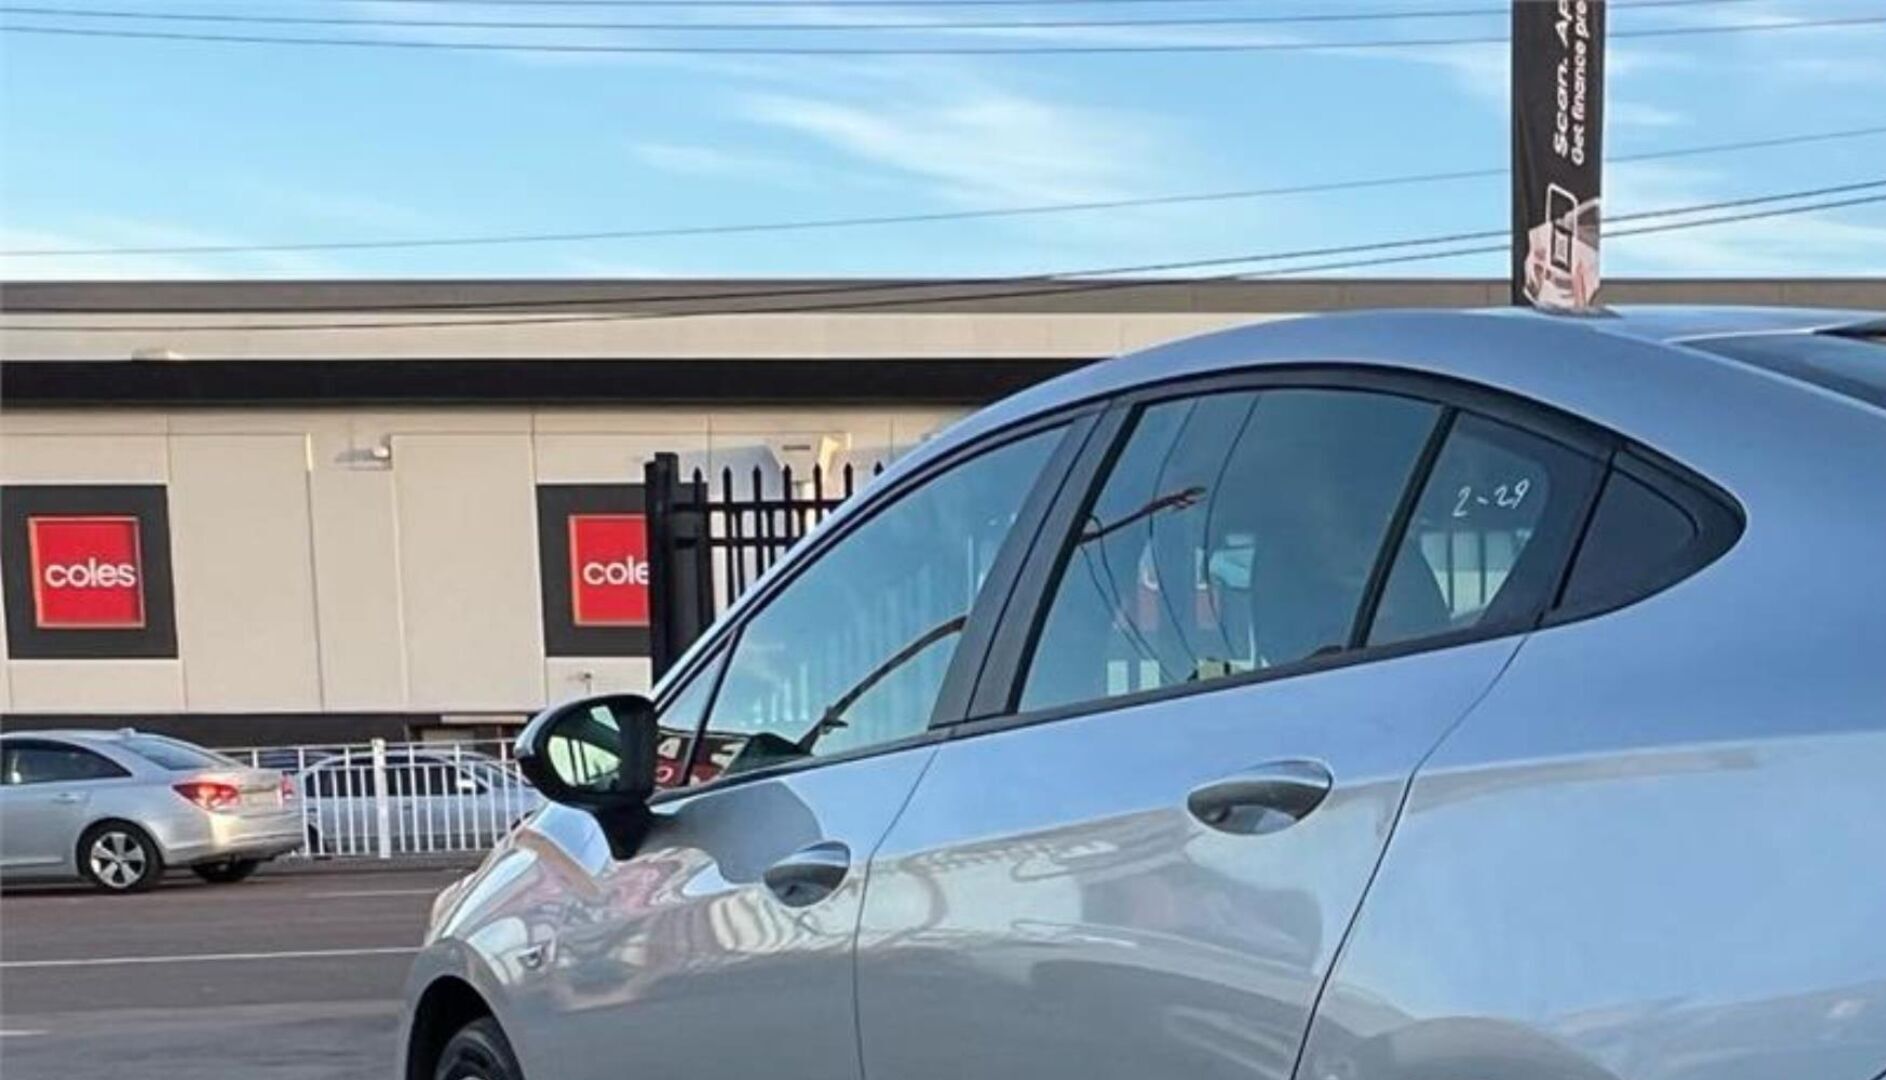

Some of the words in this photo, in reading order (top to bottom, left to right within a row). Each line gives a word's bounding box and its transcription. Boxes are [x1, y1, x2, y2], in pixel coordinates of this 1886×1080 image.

[1571, 40, 1587, 121] finance
[44, 556, 137, 588] coles
[582, 554, 650, 585] cole
